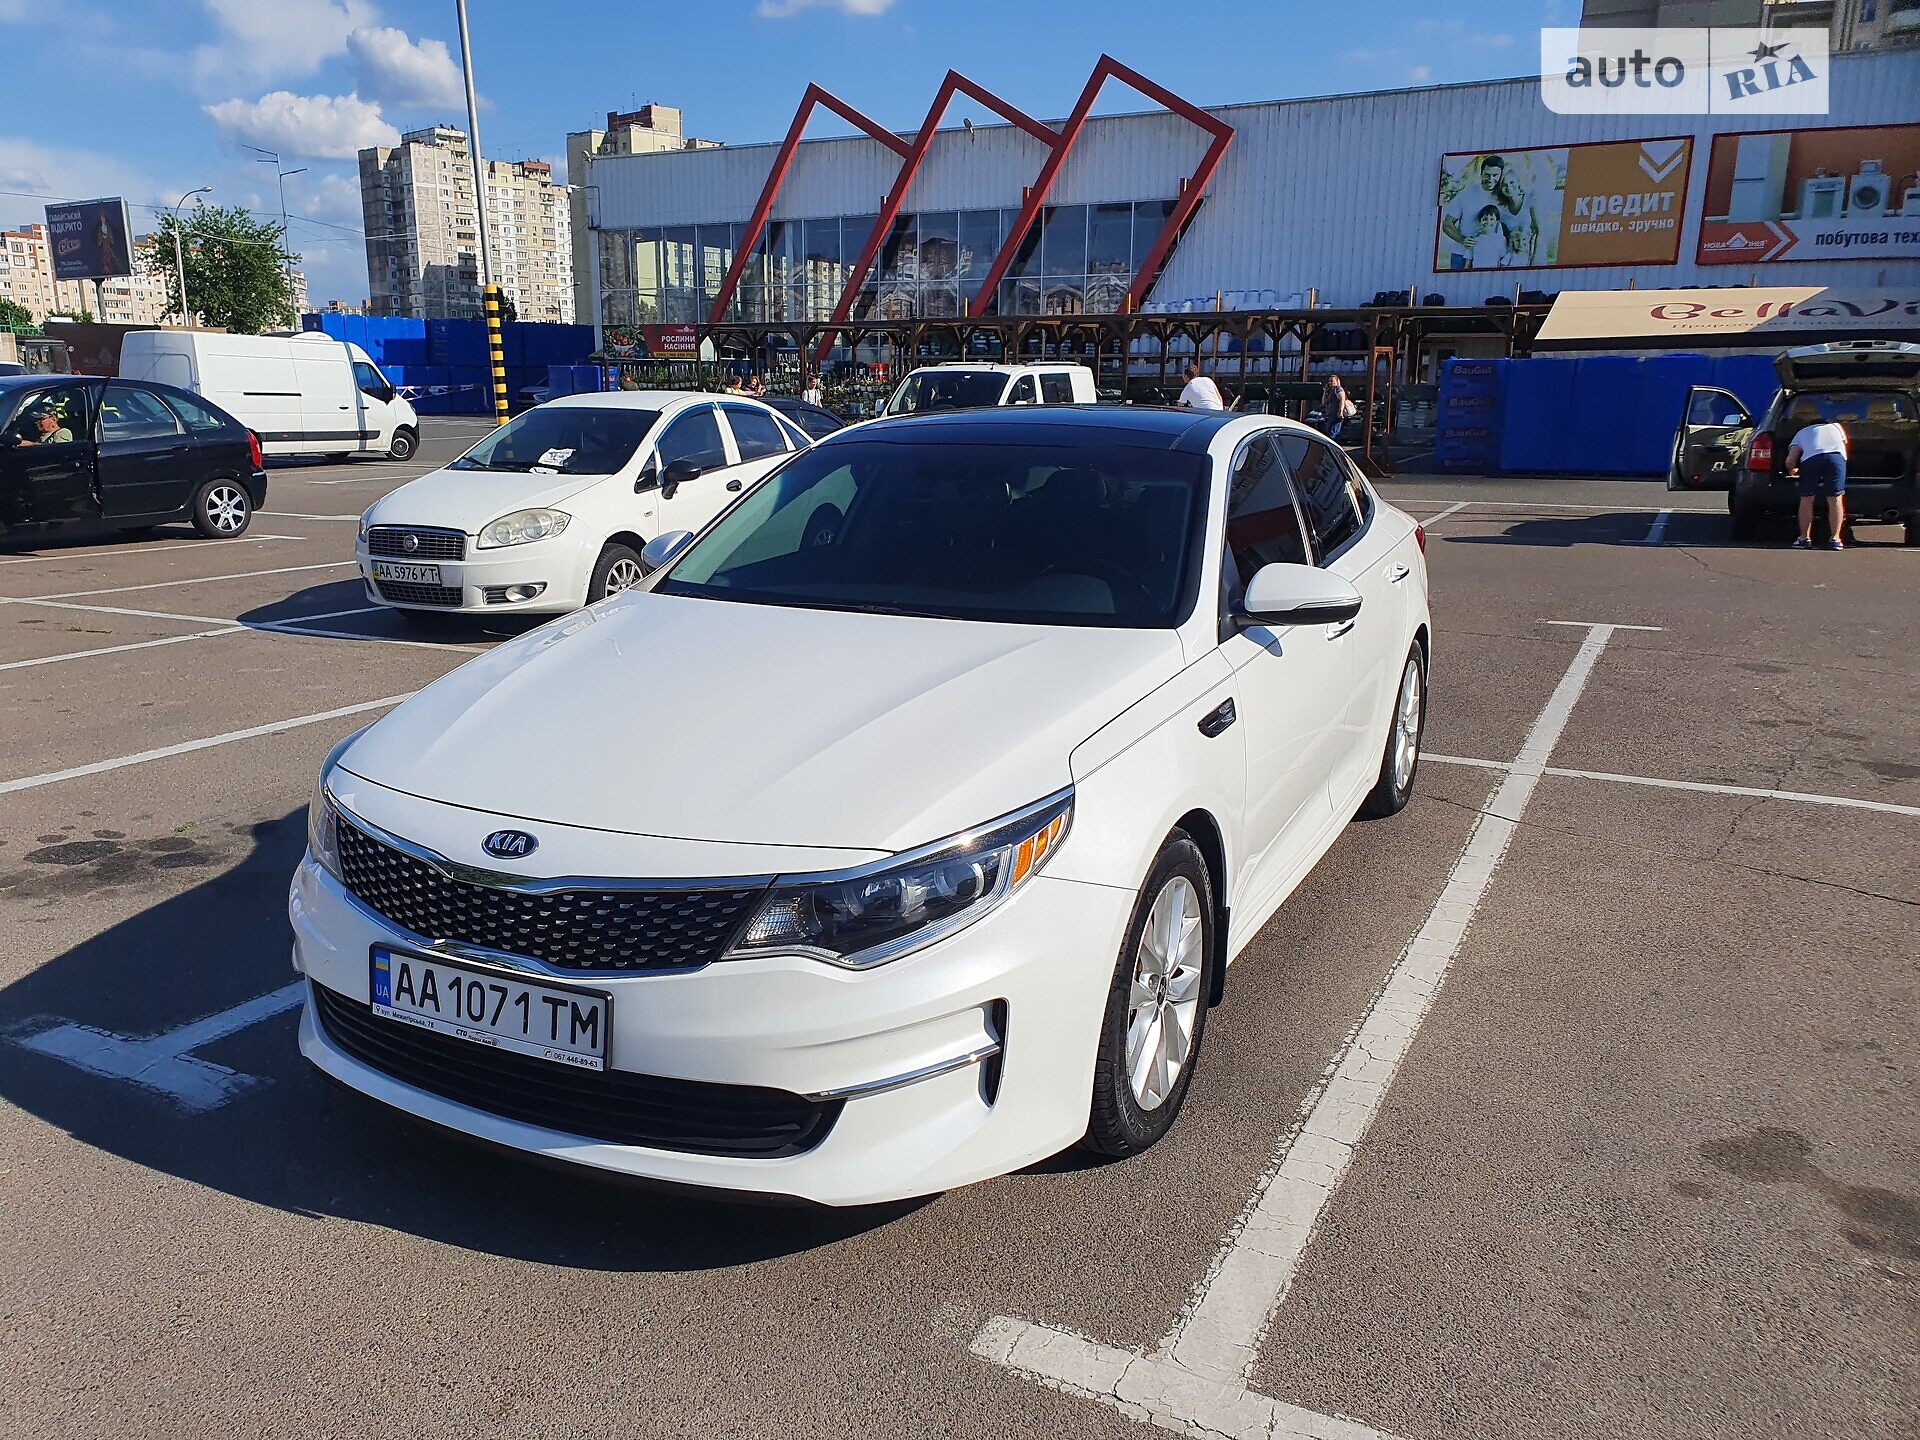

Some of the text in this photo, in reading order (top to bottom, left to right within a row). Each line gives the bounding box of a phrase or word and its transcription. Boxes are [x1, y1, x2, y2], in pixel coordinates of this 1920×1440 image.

[1574, 191, 1675, 222] кредит
[1570, 218, 1675, 233] швидко, зручно
[1815, 230, 1889, 248] побутова
[661, 335, 696, 343] РОСЛИНИ
[394, 566, 418, 580] 5976
[488, 832, 527, 854] KIA
[376, 983, 390, 998] UA
[395, 962, 599, 1049] AA 1071 TM
[553, 1052, 565, 1060] 067
